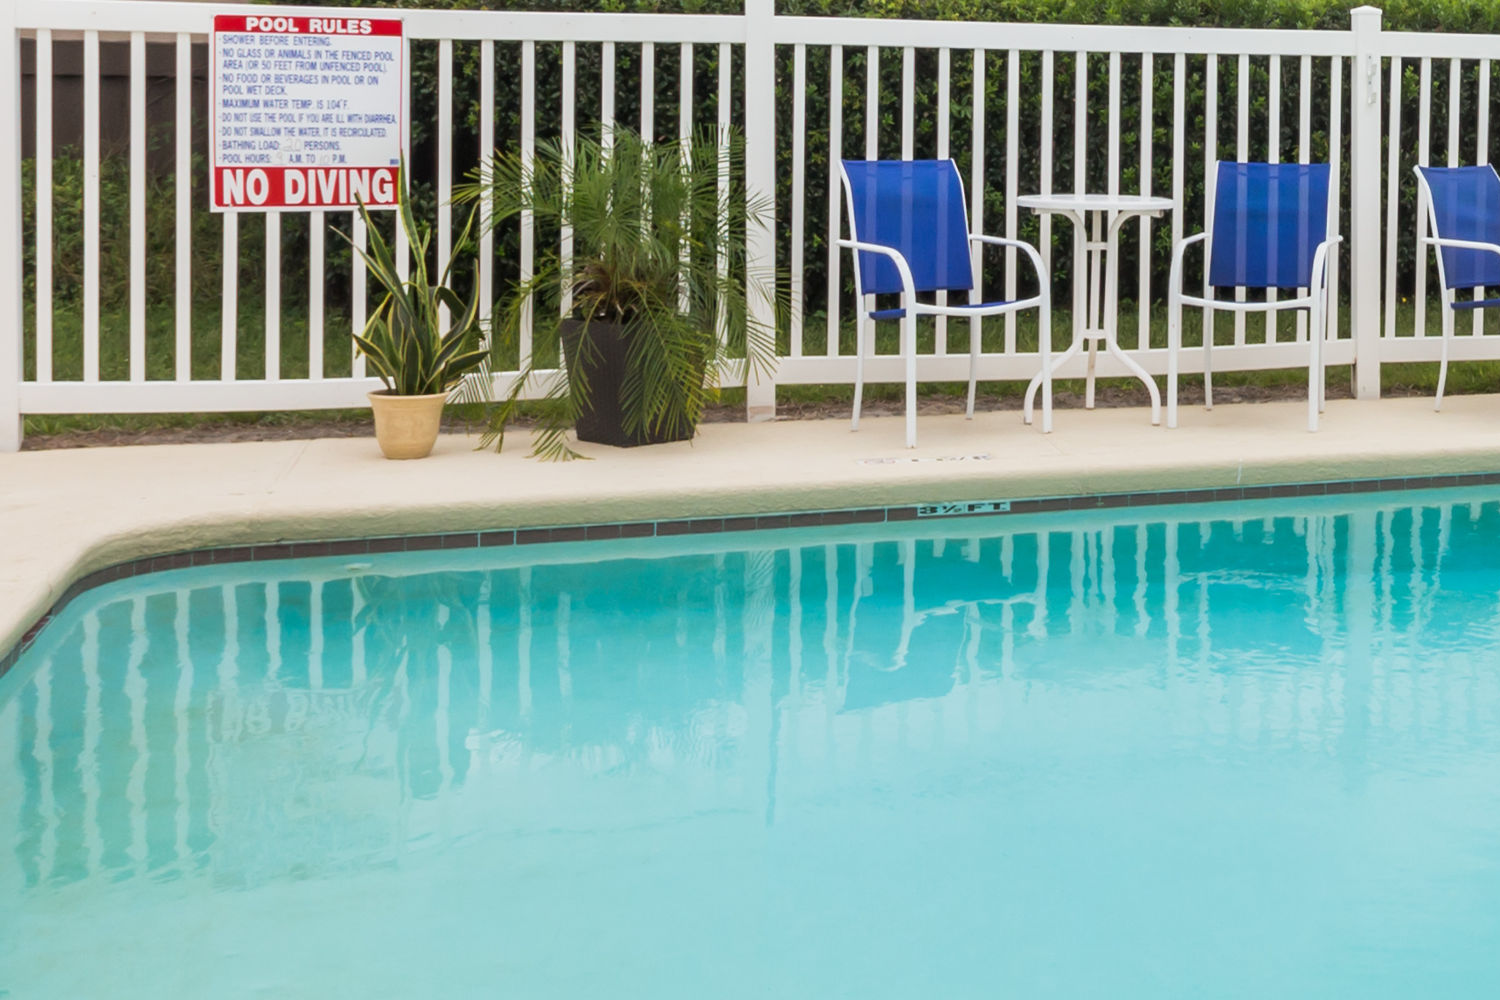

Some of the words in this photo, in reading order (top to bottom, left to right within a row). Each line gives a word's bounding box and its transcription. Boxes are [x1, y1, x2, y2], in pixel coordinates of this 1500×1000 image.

[246, 17, 298, 32] POOL
[309, 19, 372, 34] RULES
[222, 36, 255, 44] SHOWER
[260, 36, 289, 45] BEFORE
[222, 49, 233, 57] NO
[237, 49, 261, 58] GLASS
[265, 49, 275, 58] OR
[278, 50, 311, 59] ANIMALS
[314, 50, 322, 59] IN
[325, 51, 338, 59] THE
[342, 51, 371, 60] FENCED
[375, 52, 394, 61] POOL
[223, 61, 243, 69] AREA
[262, 61, 271, 70] 50
[274, 62, 292, 70] FEET
[295, 62, 317, 70] FROM
[320, 62, 360, 71] UNFENCED
[222, 74, 233, 82] NO
[237, 74, 257, 83] FOOD
[261, 74, 270, 83] OR
[274, 75, 318, 84] BEVERAGES
[321, 76, 328, 84] IN
[331, 76, 350, 85] POOL
[354, 76, 364, 85] OR
[368, 76, 378, 85] ON
[223, 86, 243, 94] POOL
[246, 86, 261, 94] WET
[222, 99, 260, 108] MAXIMUM
[263, 100, 287, 108] WATER
[317, 100, 323, 108] IS
[222, 113, 231, 121] DO
[235, 113, 247, 122] NOT
[250, 113, 262, 122] USE
[264, 114, 276, 122] THE
[279, 114, 296, 122] POOL
[298, 114, 303, 122] IF
[306, 114, 319, 123] YOU
[321, 114, 333, 123] ARE
[347, 115, 362, 123] WITH
[222, 127, 231, 135] DO
[235, 127, 247, 135] NOT
[250, 128, 281, 136] SWALLOW
[284, 128, 295, 136] THE
[322, 128, 328, 136] IT
[222, 141, 256, 149] BATHING
[222, 154, 242, 163] POOL
[306, 155, 315, 163] TO
[223, 169, 269, 204] NO
[284, 169, 393, 204] DIVING
